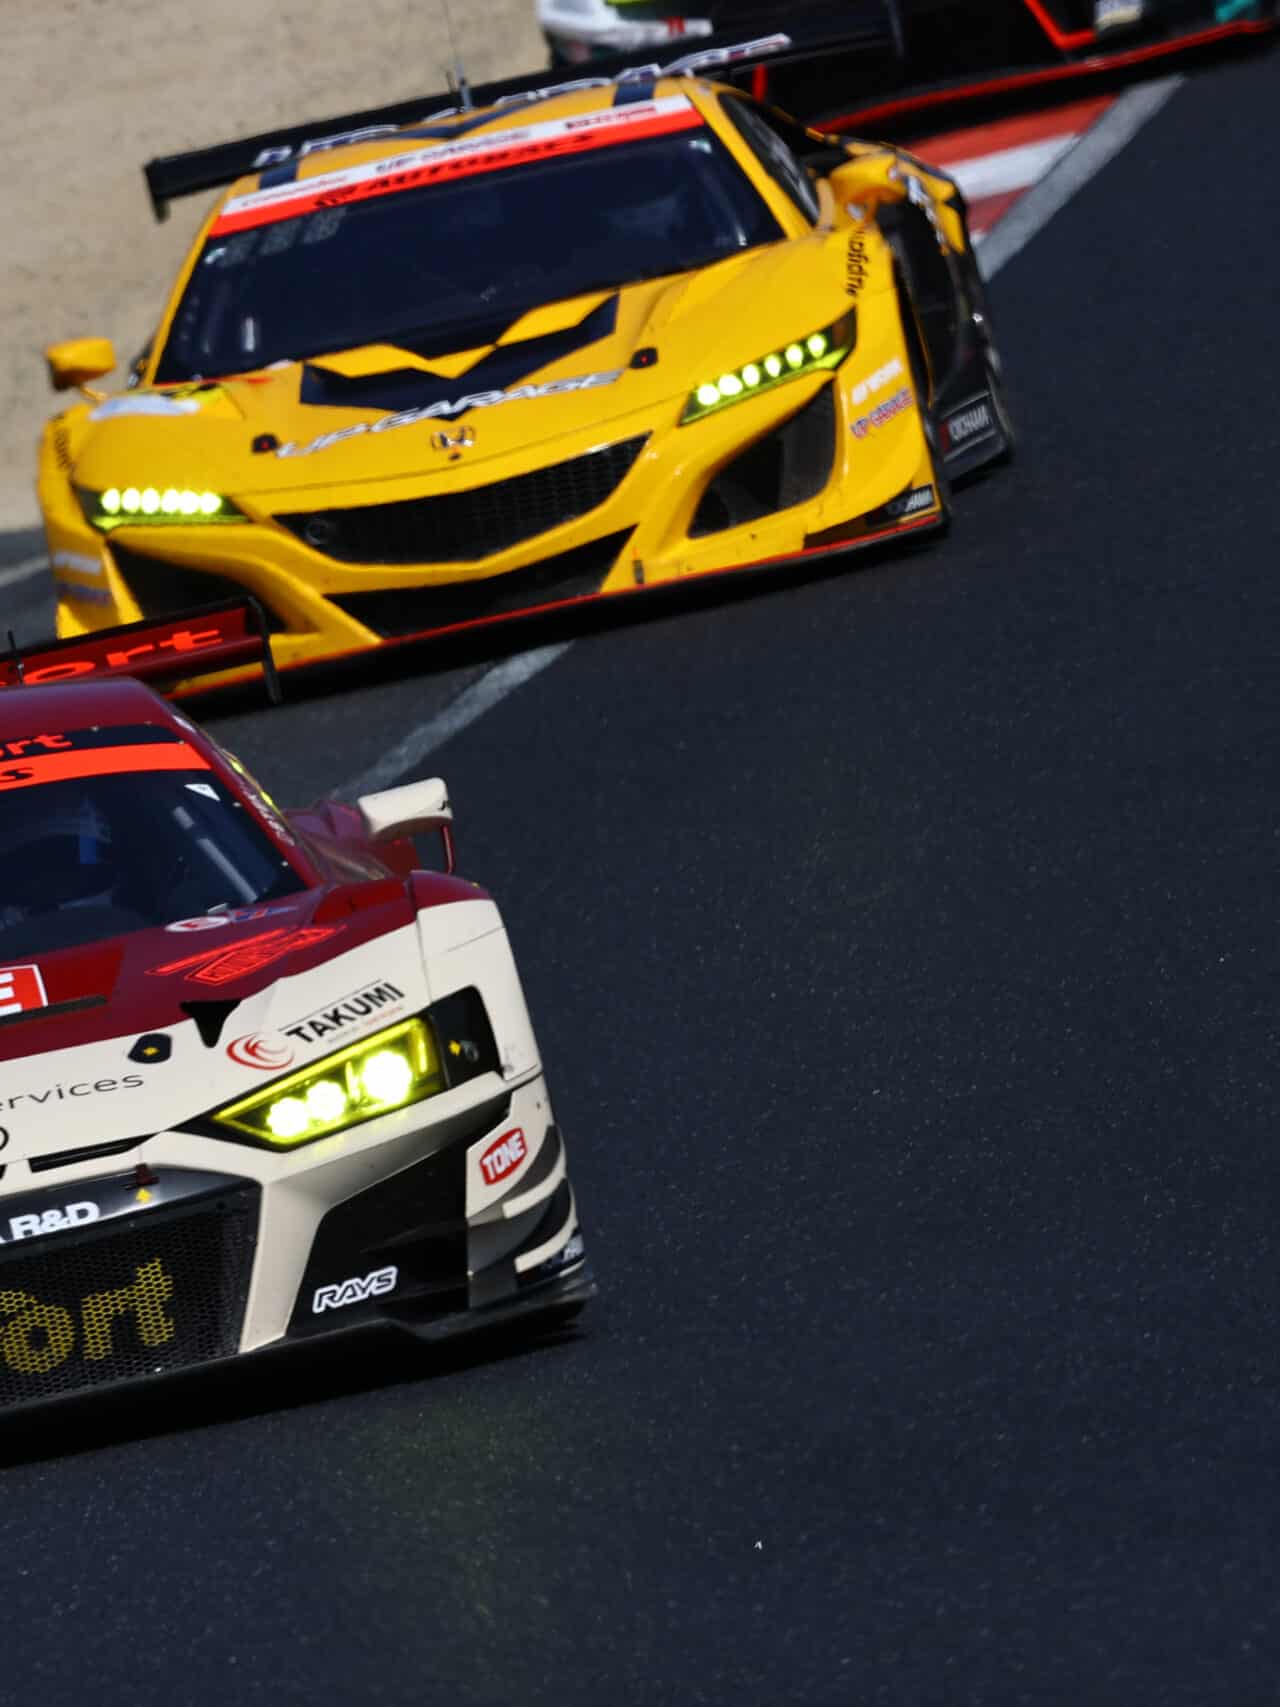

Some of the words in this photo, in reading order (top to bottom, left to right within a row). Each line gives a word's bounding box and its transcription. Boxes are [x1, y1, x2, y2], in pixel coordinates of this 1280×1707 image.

[284, 980, 406, 1044] TAKUMI
[480, 1129, 527, 1182] TONE
[8, 1200, 101, 1241] R&D
[311, 1265, 399, 1314] RAYS
